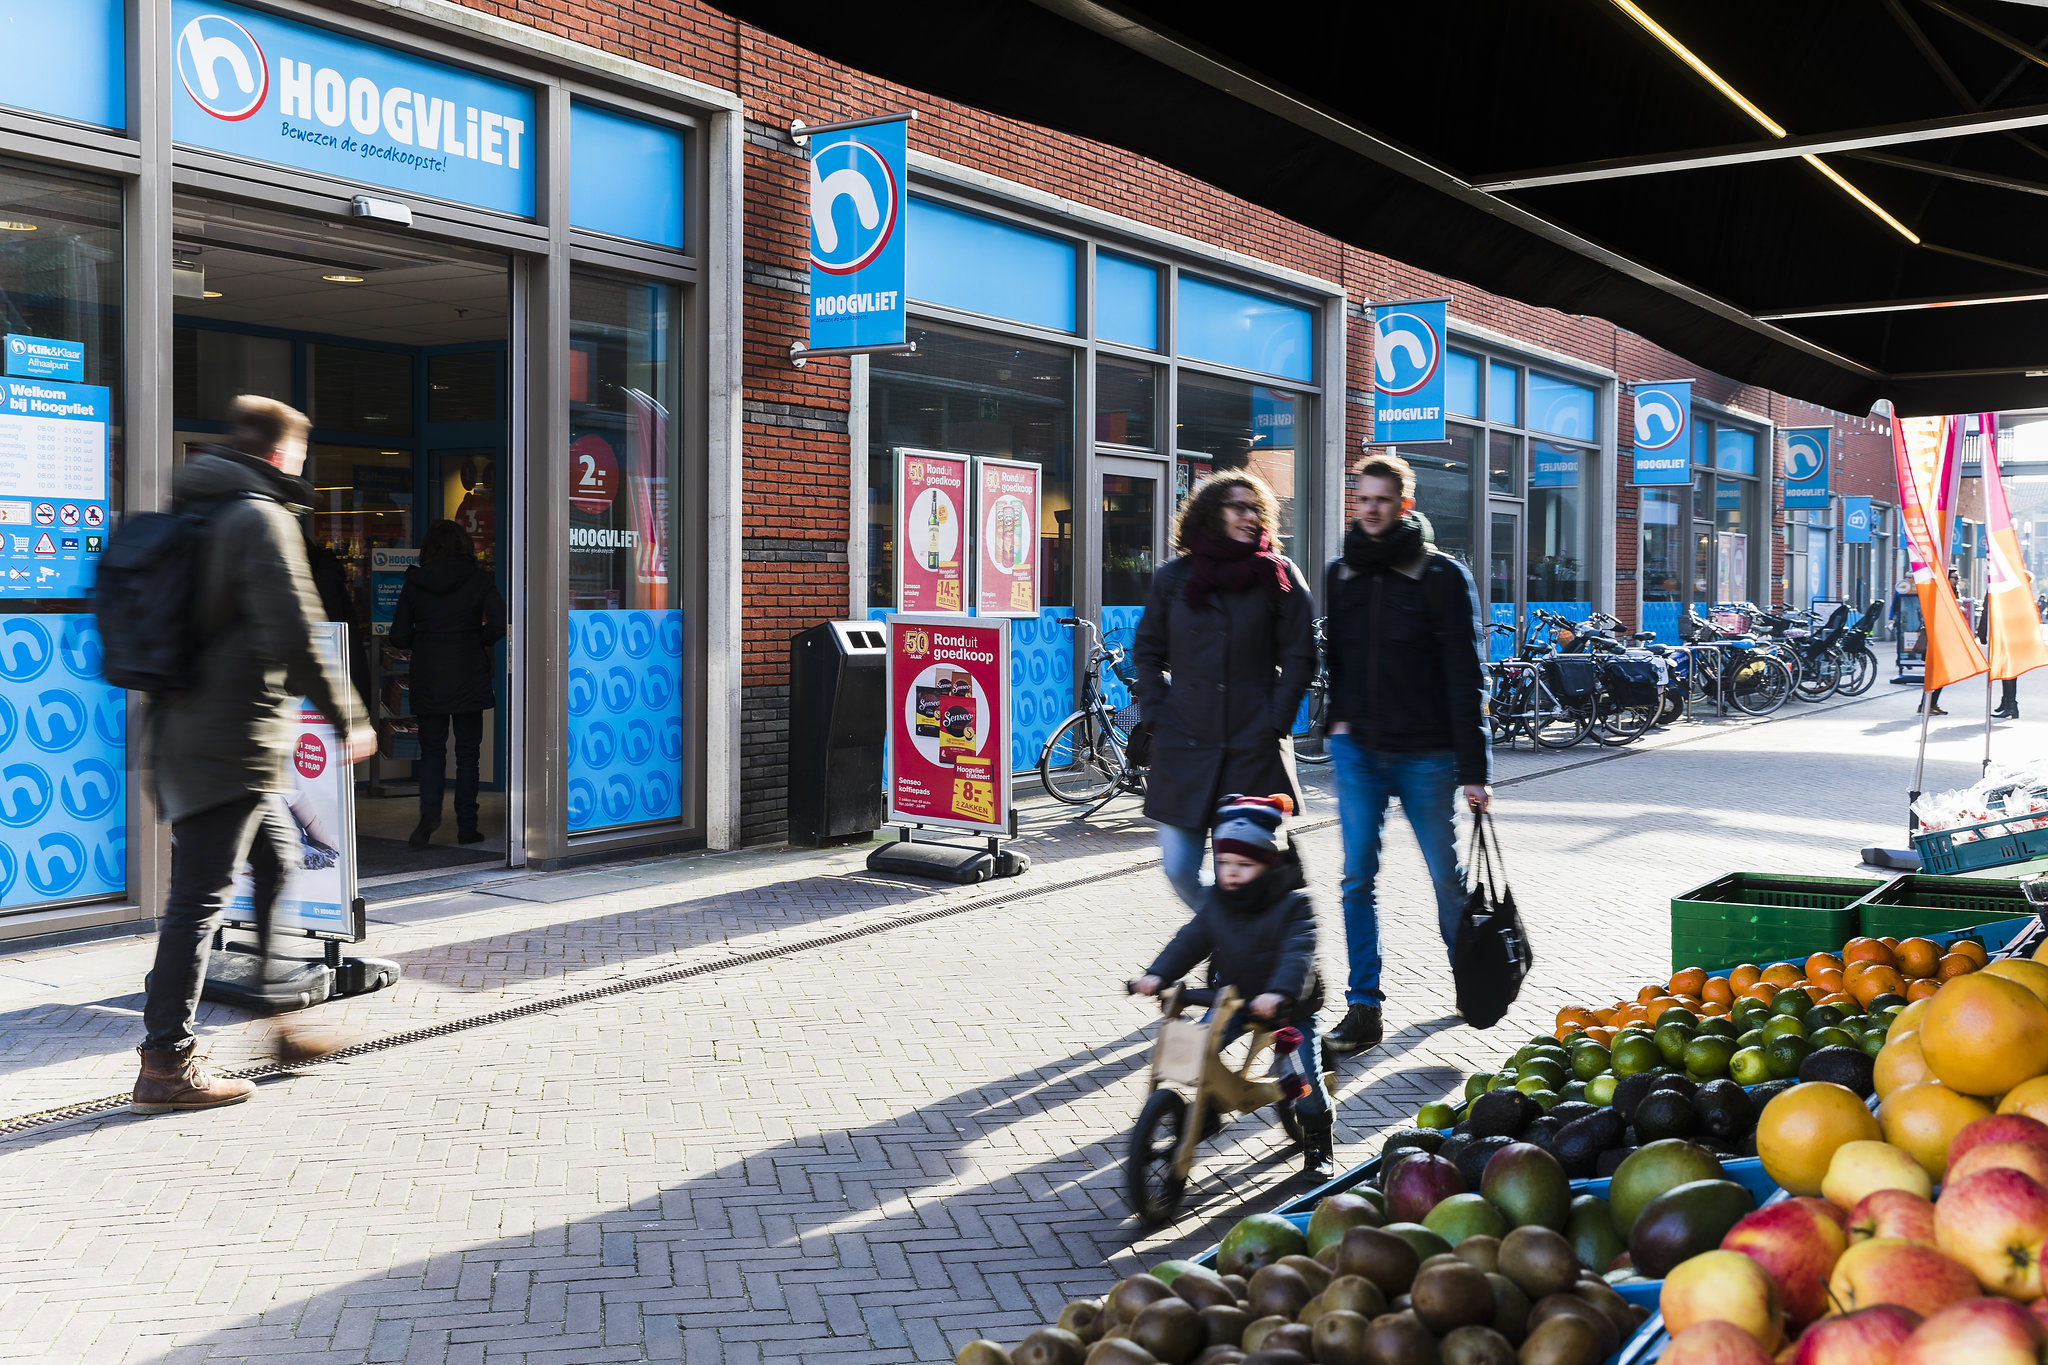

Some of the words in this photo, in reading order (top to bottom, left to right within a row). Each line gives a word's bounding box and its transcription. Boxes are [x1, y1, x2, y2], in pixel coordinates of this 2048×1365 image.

[280, 56, 525, 170] HOOGVLiET
[281, 121, 338, 150] Bewezen
[341, 135, 358, 152] de
[360, 140, 448, 173] goedkoopste!
[27, 343, 81, 360] Klik&Klaar
[27, 357, 70, 371] Afhaalpunt
[9, 383, 67, 401] Welkom
[9, 397, 28, 413] bij
[30, 399, 95, 417] Hoogvliet
[926, 463, 953, 476] Ronduit
[926, 475, 961, 489] goedkoop
[1001, 483, 1033, 495] goedkoop
[904, 630, 929, 655] 50
[933, 632, 979, 649] Ronduit
[933, 648, 994, 665] goedkoop
[942, 711, 974, 728] Senseo
[300, 741, 304, 749] 1
[304, 743, 321, 752] zegel
[295, 750, 304, 760] bij
[304, 752, 325, 762] iedere
[304, 762, 320, 771] 10,00
[956, 765, 985, 776] Hoogvliet
[898, 776, 922, 787] Senseo
[898, 785, 931, 797] koffiepads
[961, 801, 989, 815] ZAKKEN
